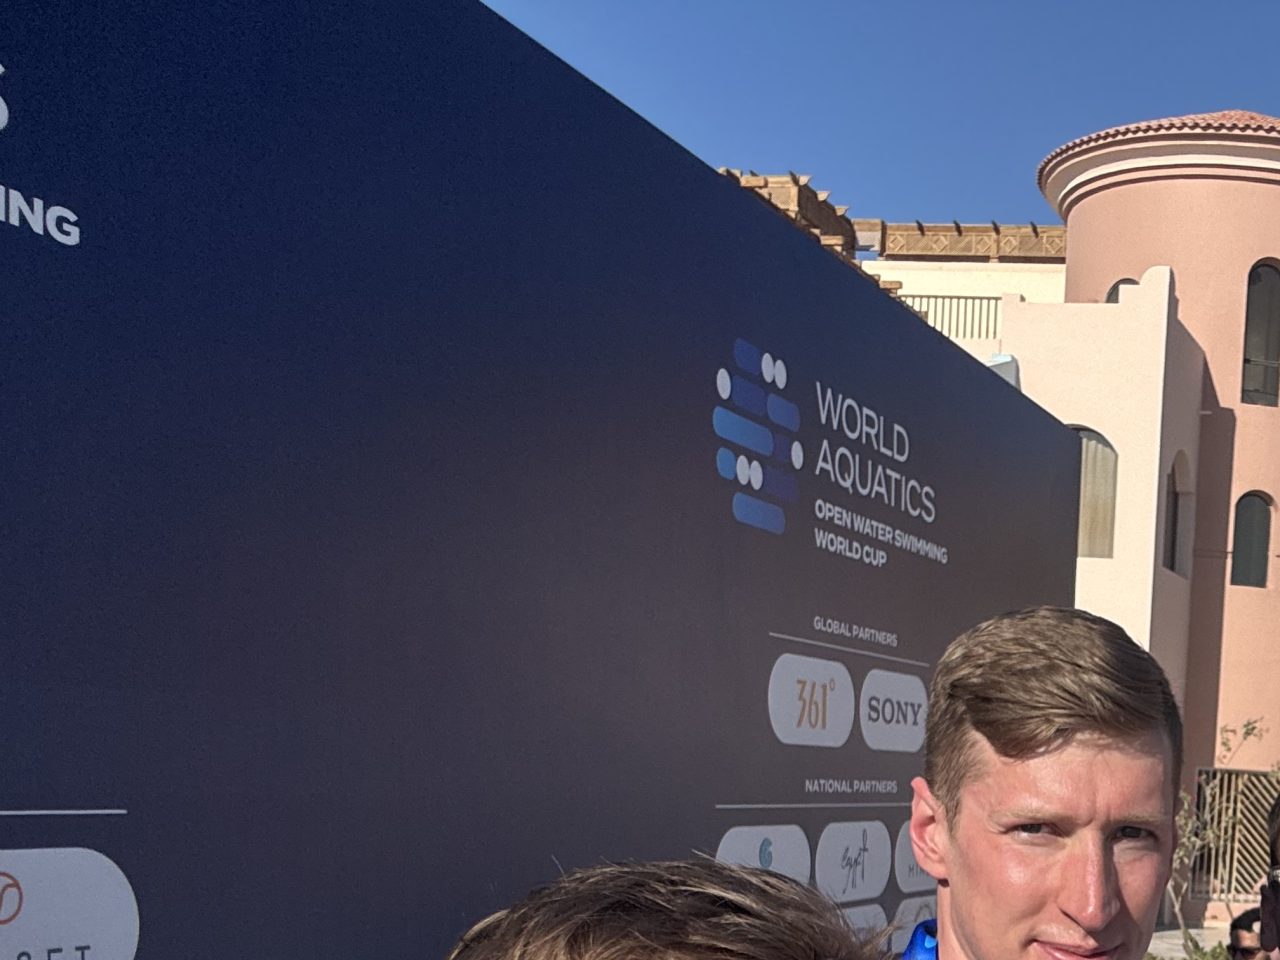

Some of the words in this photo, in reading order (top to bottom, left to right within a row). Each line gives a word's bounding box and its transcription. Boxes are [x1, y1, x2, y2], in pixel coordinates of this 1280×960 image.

[816, 381, 909, 462] WORLD
[815, 439, 935, 523] AQUATICS
[814, 527, 861, 560] WORLD
[862, 545, 887, 567] CUP
[815, 499, 852, 529] OPEN
[853, 512, 893, 544] WATER
[894, 529, 948, 564] SWIMMING
[813, 616, 851, 637] GLOBAL
[852, 624, 898, 647] PARTNERS
[868, 695, 923, 726] SONY
[805, 778, 852, 793] NATIONAL
[853, 780, 898, 794] PARTNERS
